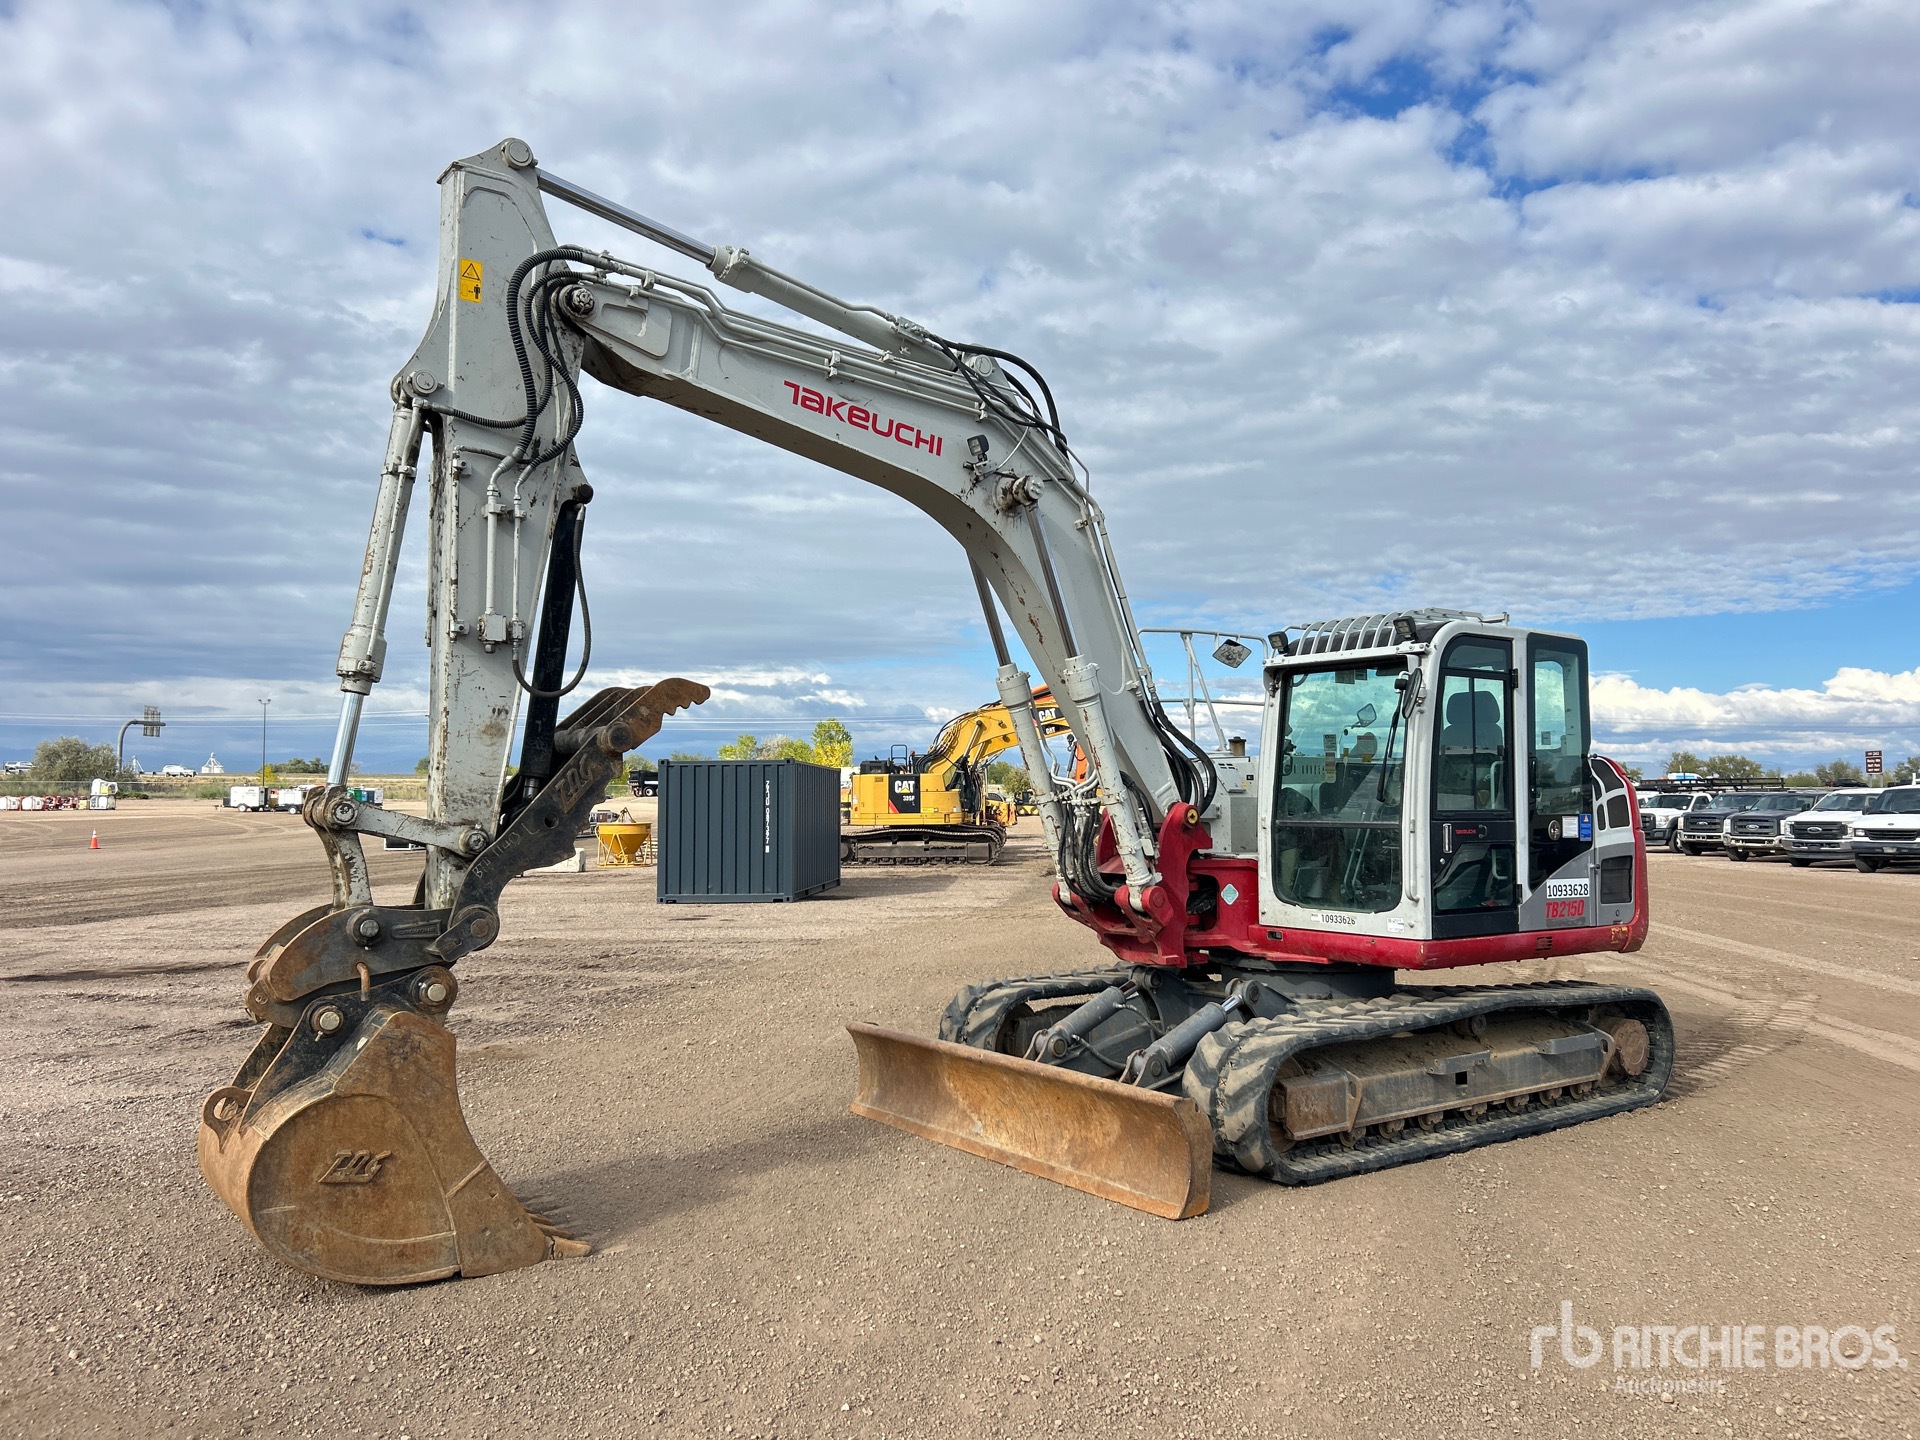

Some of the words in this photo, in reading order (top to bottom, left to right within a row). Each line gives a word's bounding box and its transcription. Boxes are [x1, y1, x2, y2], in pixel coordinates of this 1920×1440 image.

[1039, 708, 1056, 722] CAT
[895, 781, 915, 793] CAT
[1547, 884, 1589, 897] 10933628
[1545, 899, 1585, 918] TB2150
